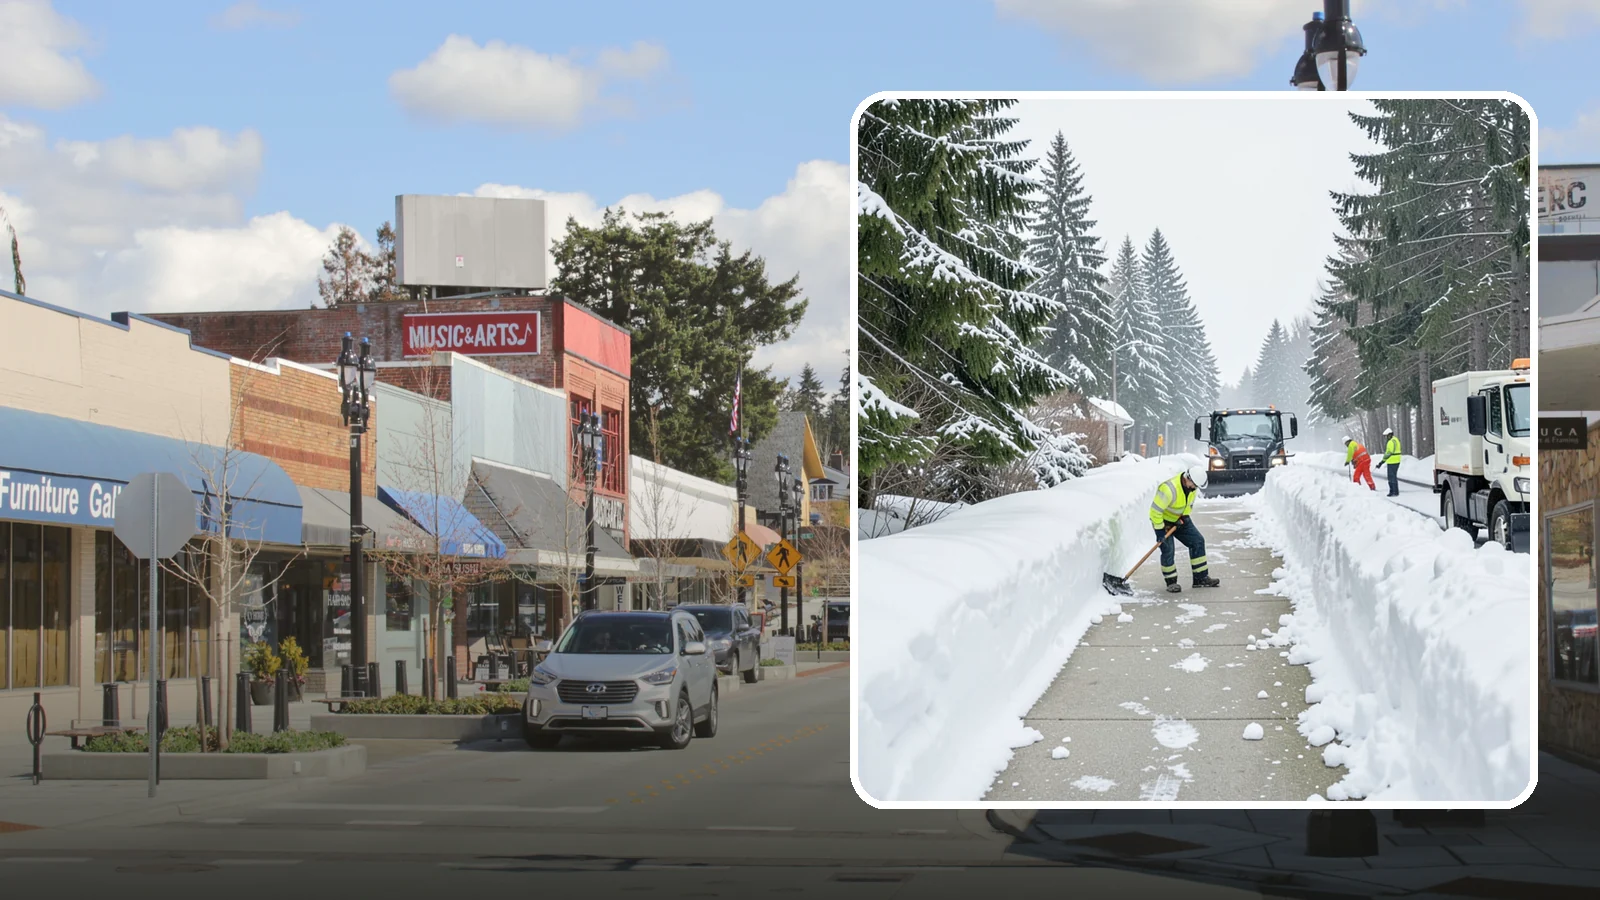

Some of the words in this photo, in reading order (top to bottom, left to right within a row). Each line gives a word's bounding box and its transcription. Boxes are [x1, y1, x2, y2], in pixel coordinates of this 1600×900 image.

[409, 323, 519, 348] MUSIC&ARTS
[1540, 428, 1577, 436] UGA
[0, 471, 79, 515] Furniture
[453, 563, 479, 574] SUSHI
